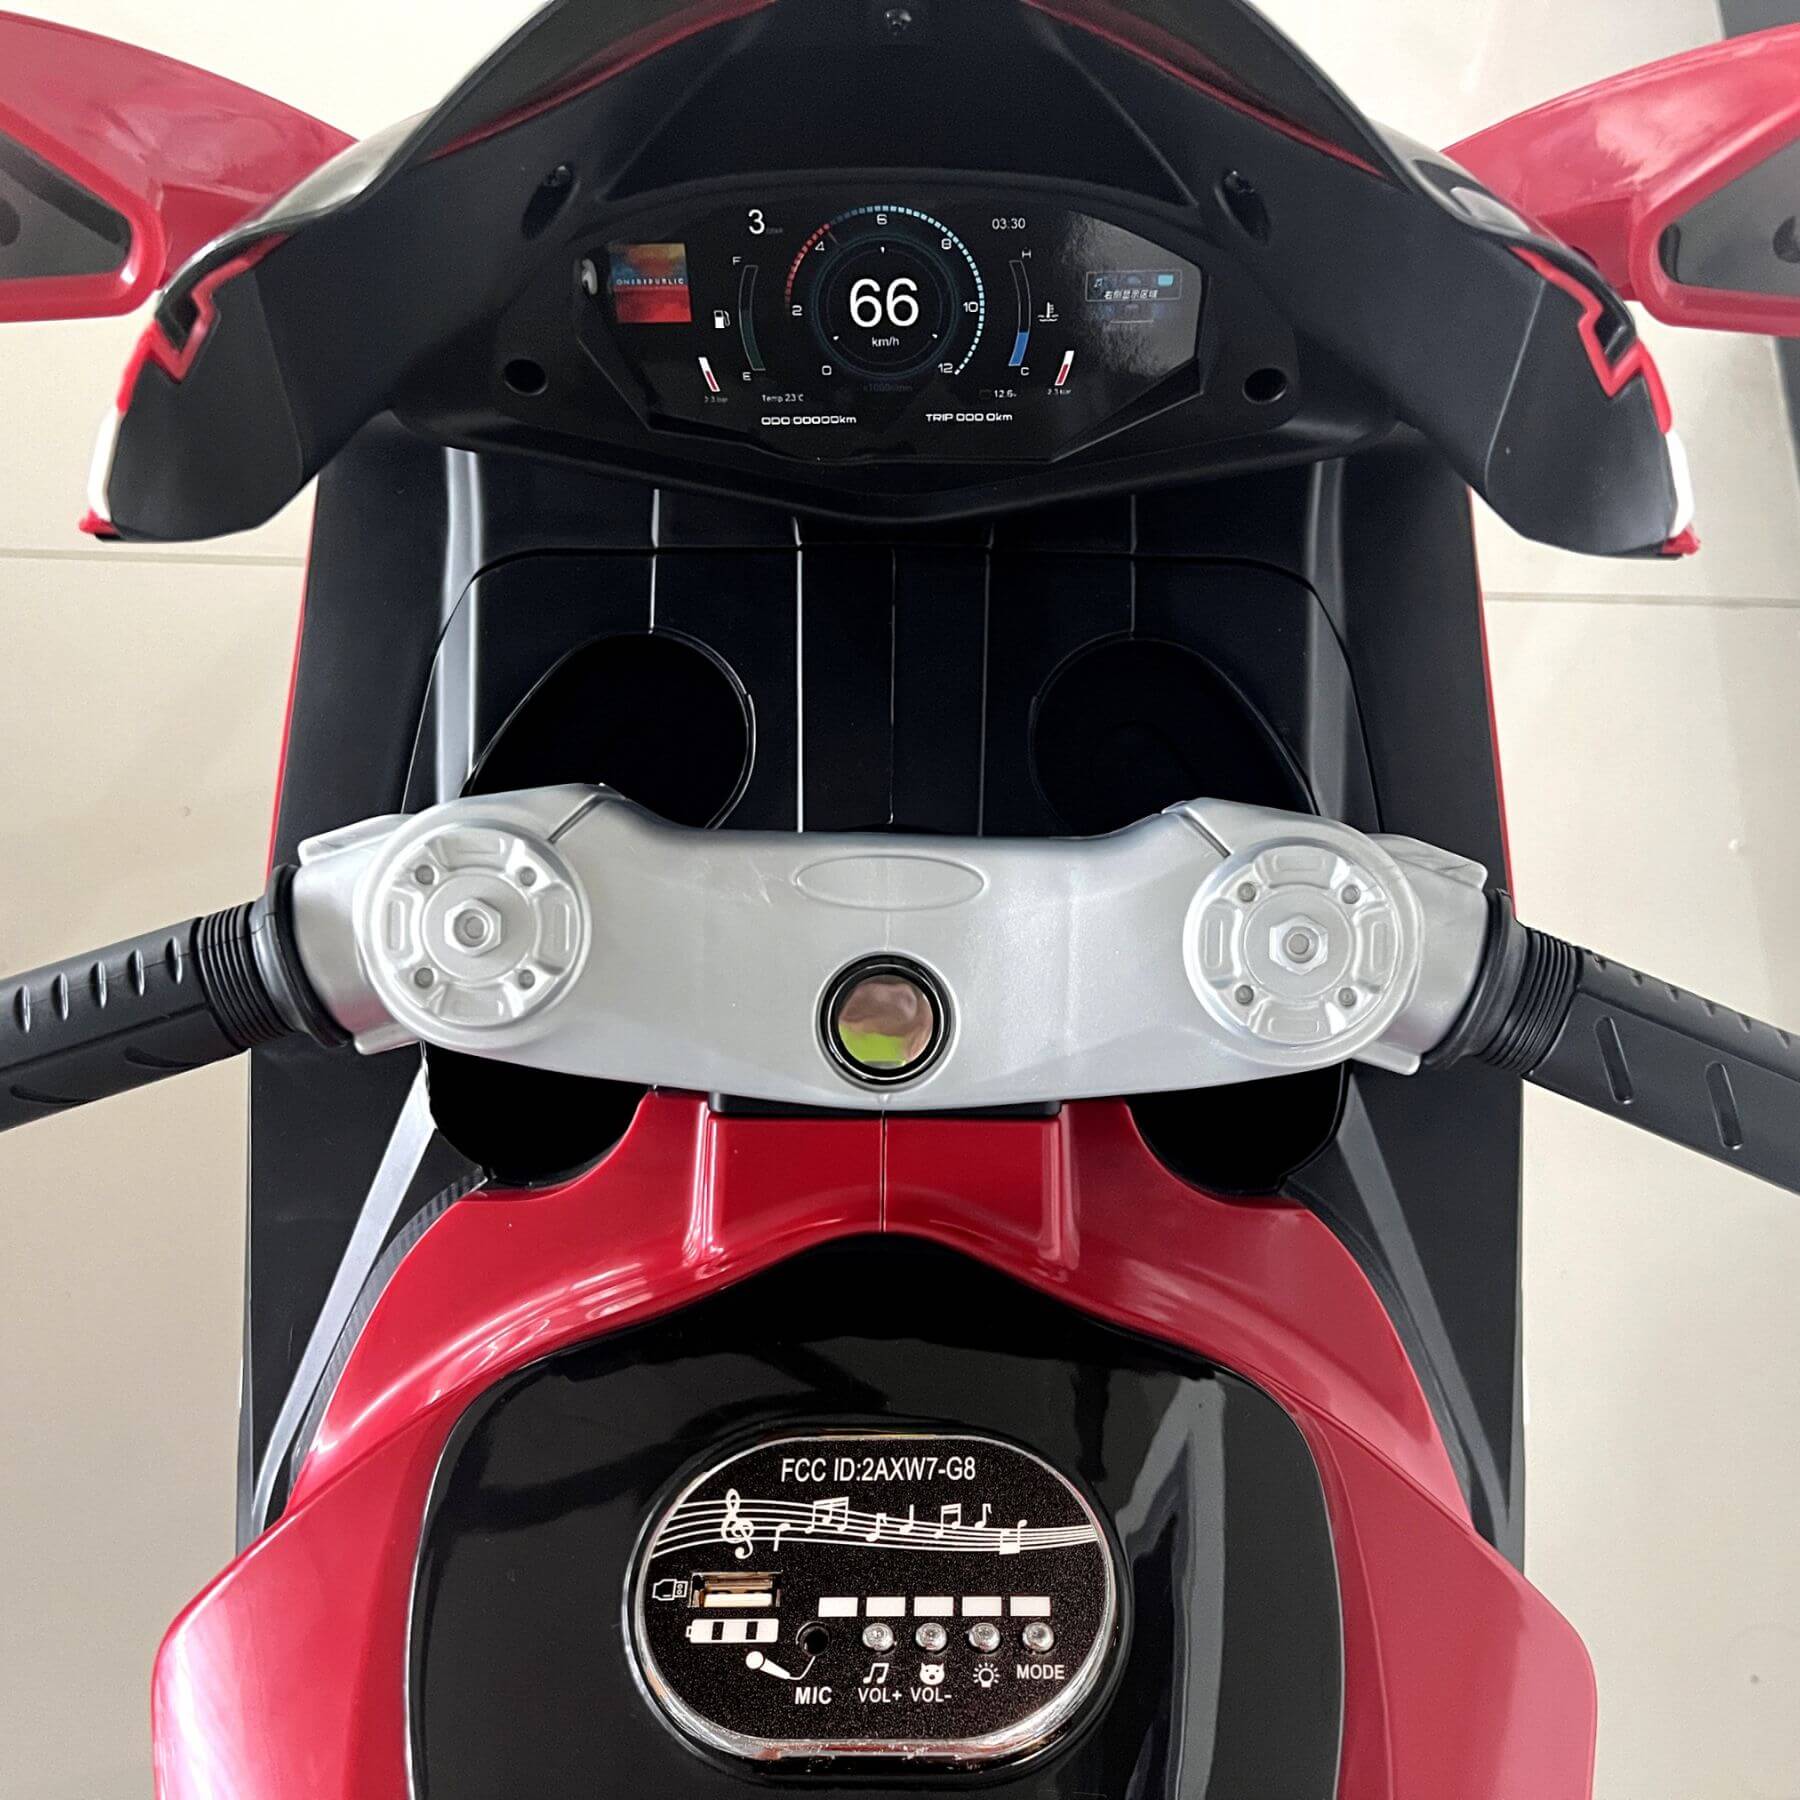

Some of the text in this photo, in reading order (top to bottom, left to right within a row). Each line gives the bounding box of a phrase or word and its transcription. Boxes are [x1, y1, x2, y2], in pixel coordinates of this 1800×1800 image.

[749, 209, 764, 234] 3
[877, 214, 887, 224] 6
[815, 241, 824, 250] 4
[942, 239, 951, 249] 8
[1021, 250, 1032, 258] H
[732, 256, 742, 265] F
[850, 278, 918, 327] 66
[963, 302, 978, 312] 10
[792, 305, 802, 315] 2
[871, 336, 900, 347] km/h
[938, 363, 953, 373] 12
[1020, 366, 1030, 376] C
[742, 371, 751, 381] E
[761, 394, 784, 403] Temp
[781, 1456, 975, 1482] FCC ID:2AXW7-G8
[1017, 1664, 1064, 1679] MODE
[795, 1686, 832, 1704] MIC
[858, 1688, 902, 1703] VOL+
[910, 1687, 951, 1702] VOL-
